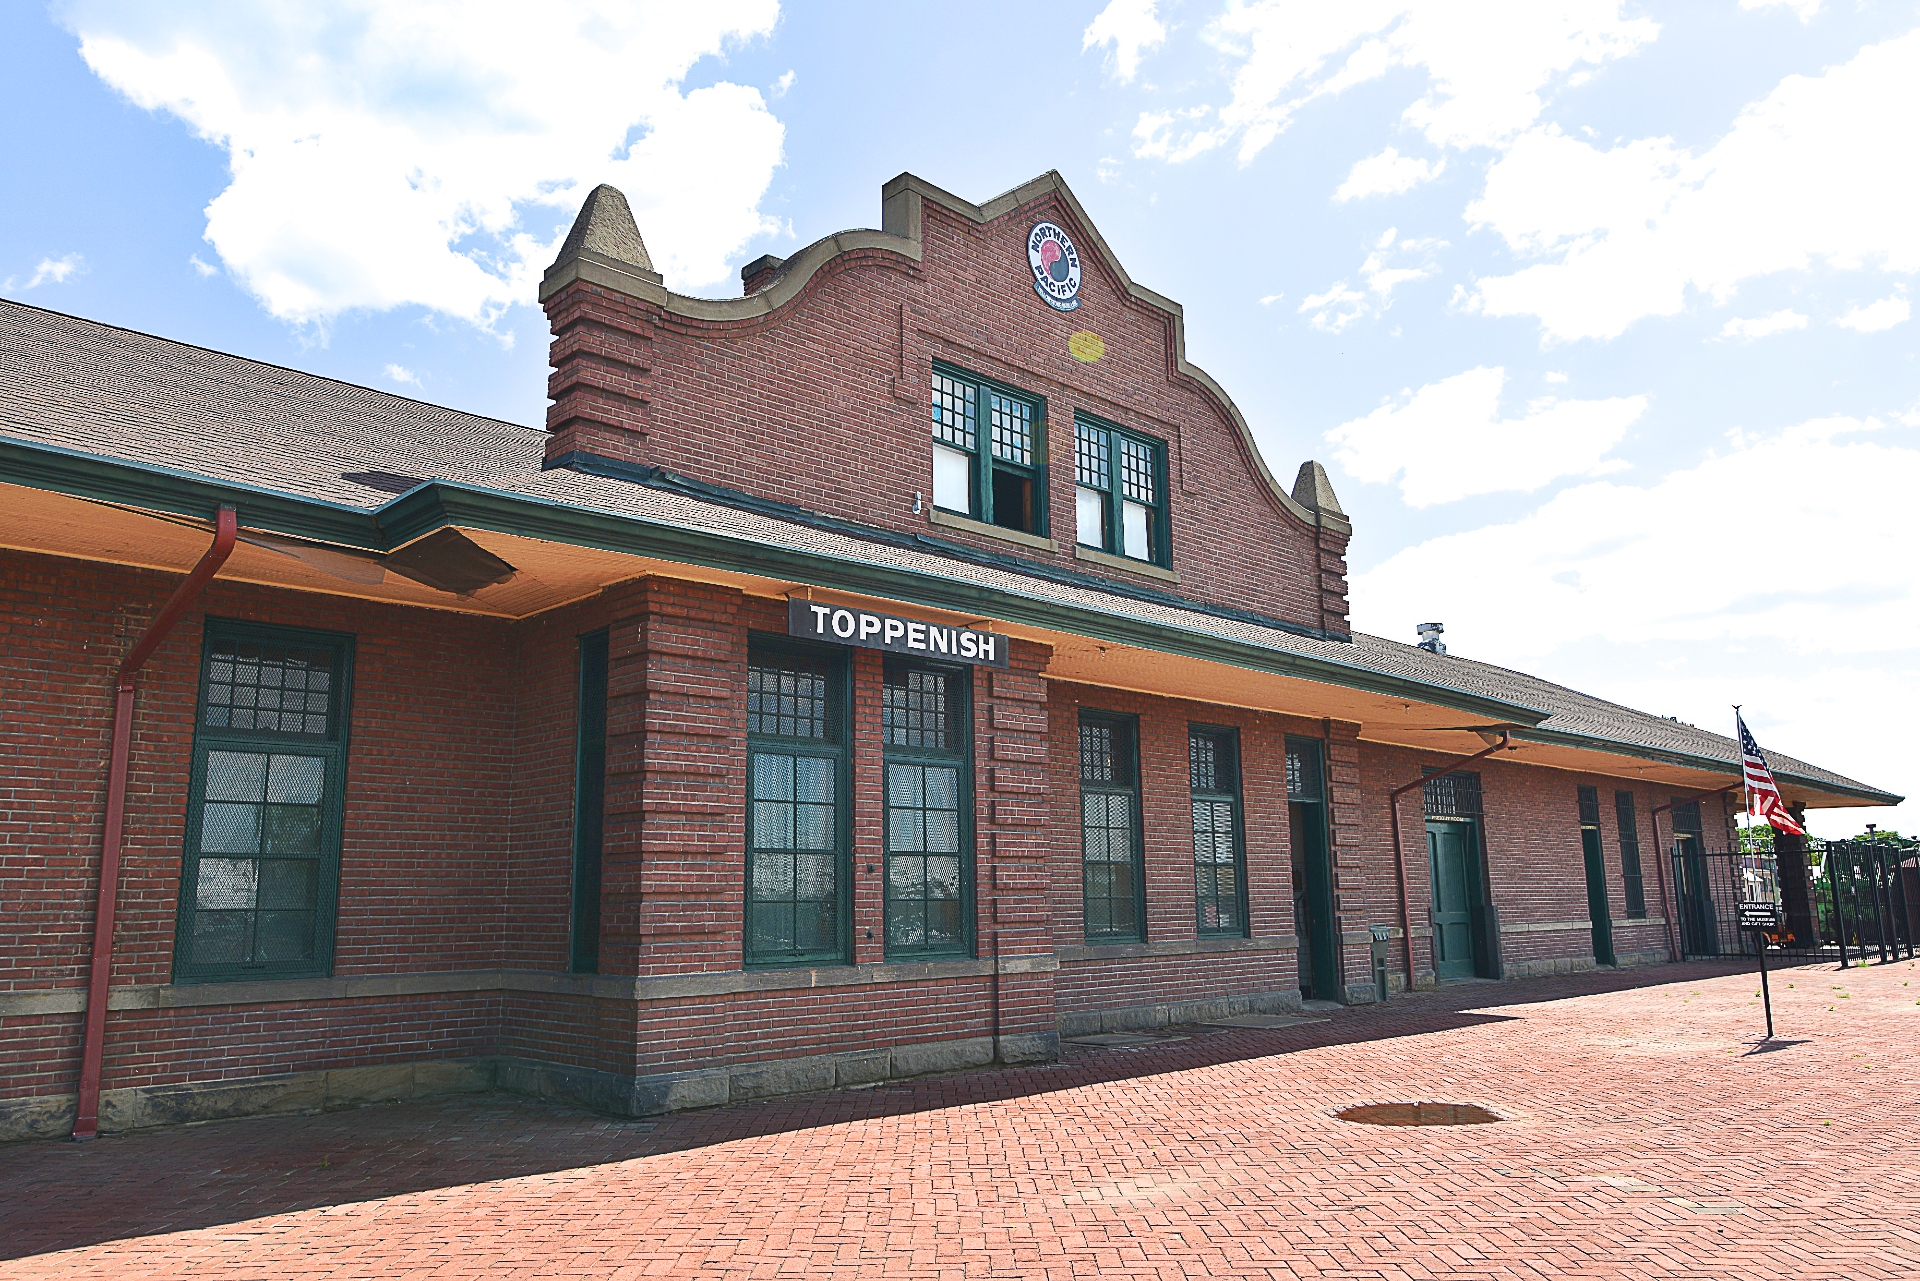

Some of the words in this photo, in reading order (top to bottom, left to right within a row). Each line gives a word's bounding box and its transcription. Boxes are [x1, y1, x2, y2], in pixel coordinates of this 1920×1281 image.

[1031, 226, 1078, 269] NORTHERN
[1035, 264, 1077, 296] PACIFIC
[810, 605, 995, 661] TOPPENISH
